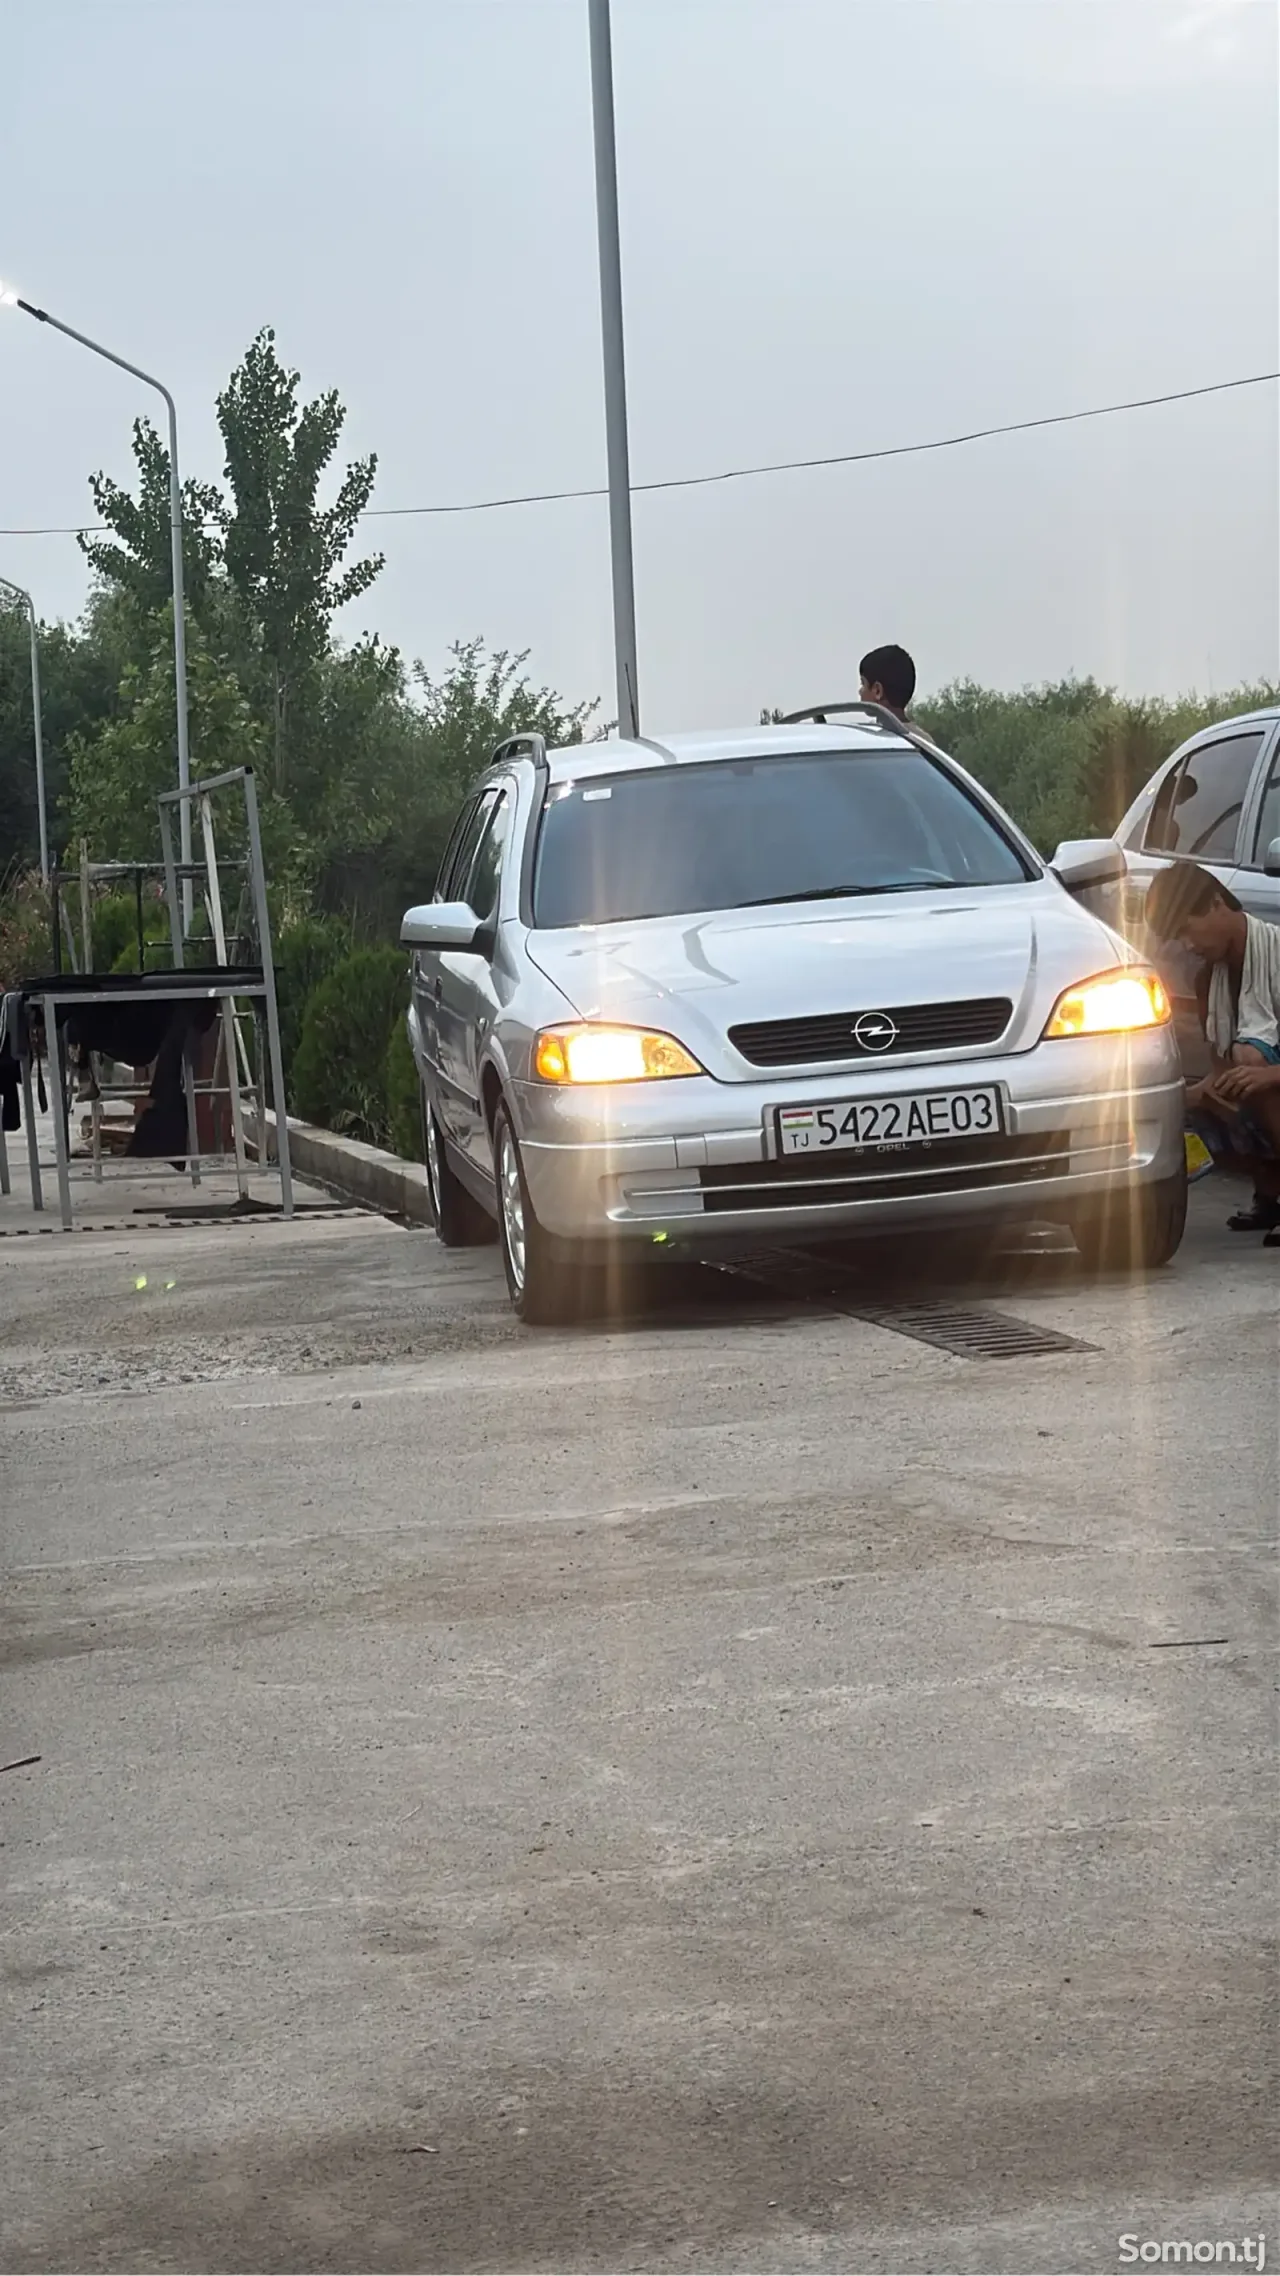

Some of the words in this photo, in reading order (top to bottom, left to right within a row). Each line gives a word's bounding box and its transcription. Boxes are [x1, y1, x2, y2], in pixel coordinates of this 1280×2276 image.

[816, 1094, 993, 1145] 5422AE03
[791, 1133, 809, 1149] TJ
[876, 1142, 910, 1153] OPEL
